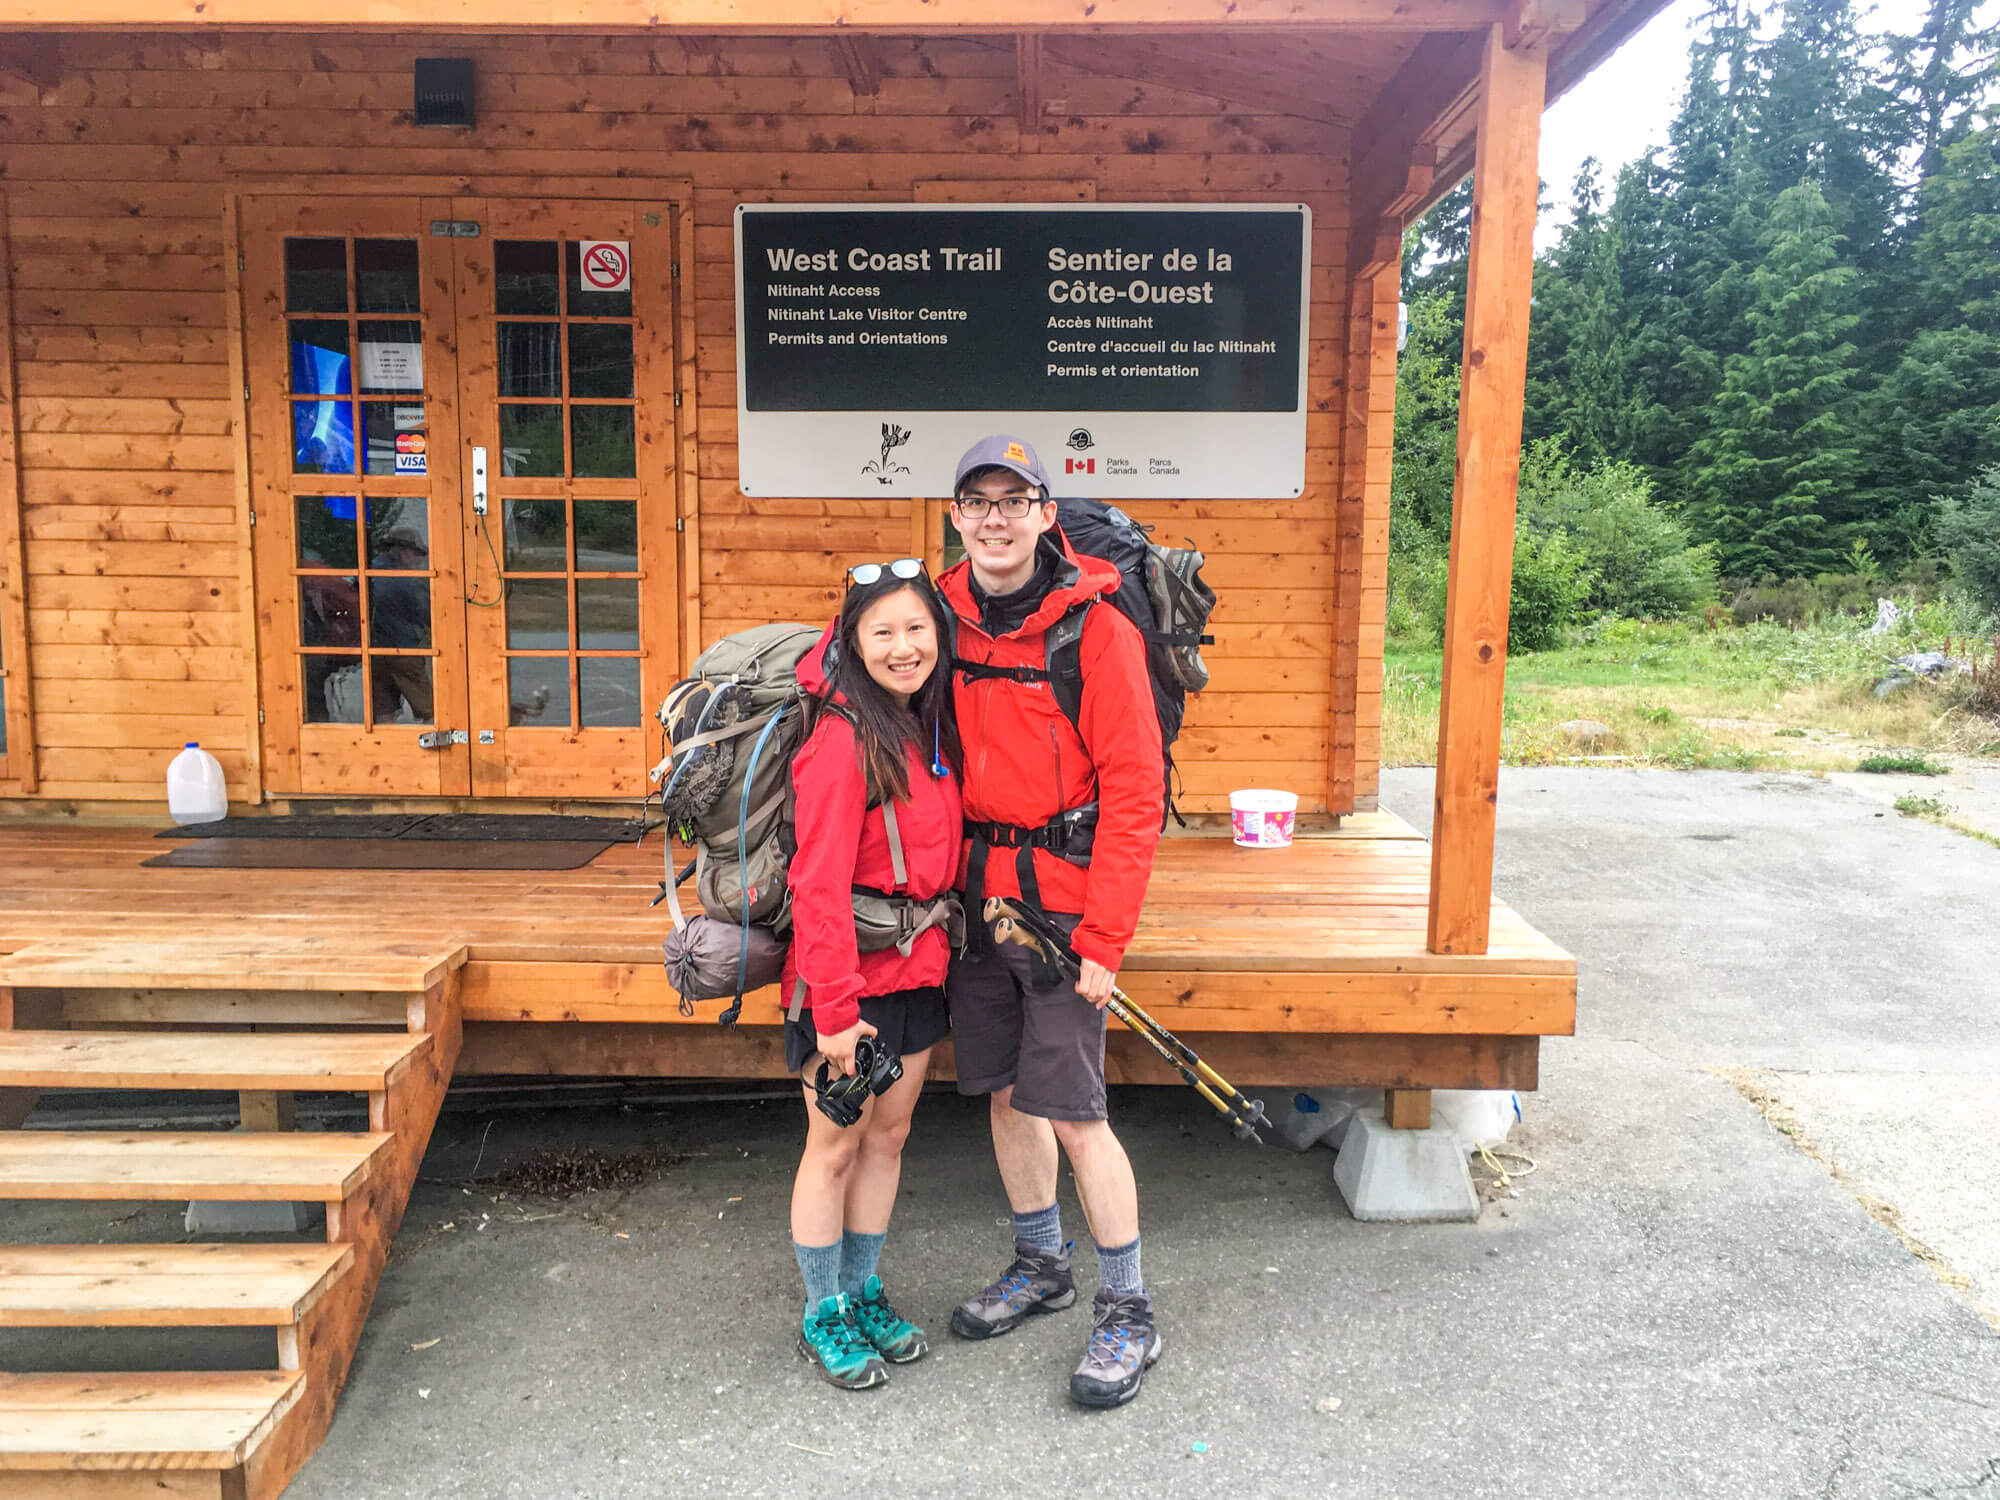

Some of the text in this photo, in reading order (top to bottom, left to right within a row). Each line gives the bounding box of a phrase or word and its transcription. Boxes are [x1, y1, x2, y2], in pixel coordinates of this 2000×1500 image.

[766, 247, 1001, 272] West Coast Trail
[1047, 247, 1232, 272] Sentier de la
[767, 284, 881, 297] Nitinaht Access
[1048, 279, 1214, 304] Côte-Ouest
[768, 307, 968, 321] Nitinaht Lake Visitor Centre
[1046, 315, 1154, 329] Accès Nitinaht
[768, 331, 948, 345] Permits and Orientations
[1047, 339, 1276, 353] Centre d'accueil du lac Nitinaht
[1047, 364, 1199, 377] Permis et orientation
[400, 456, 426, 466] VISA
[1106, 457, 1129, 466] Parks
[1106, 466, 1137, 475] Canada
[1149, 466, 1180, 475] Canada
